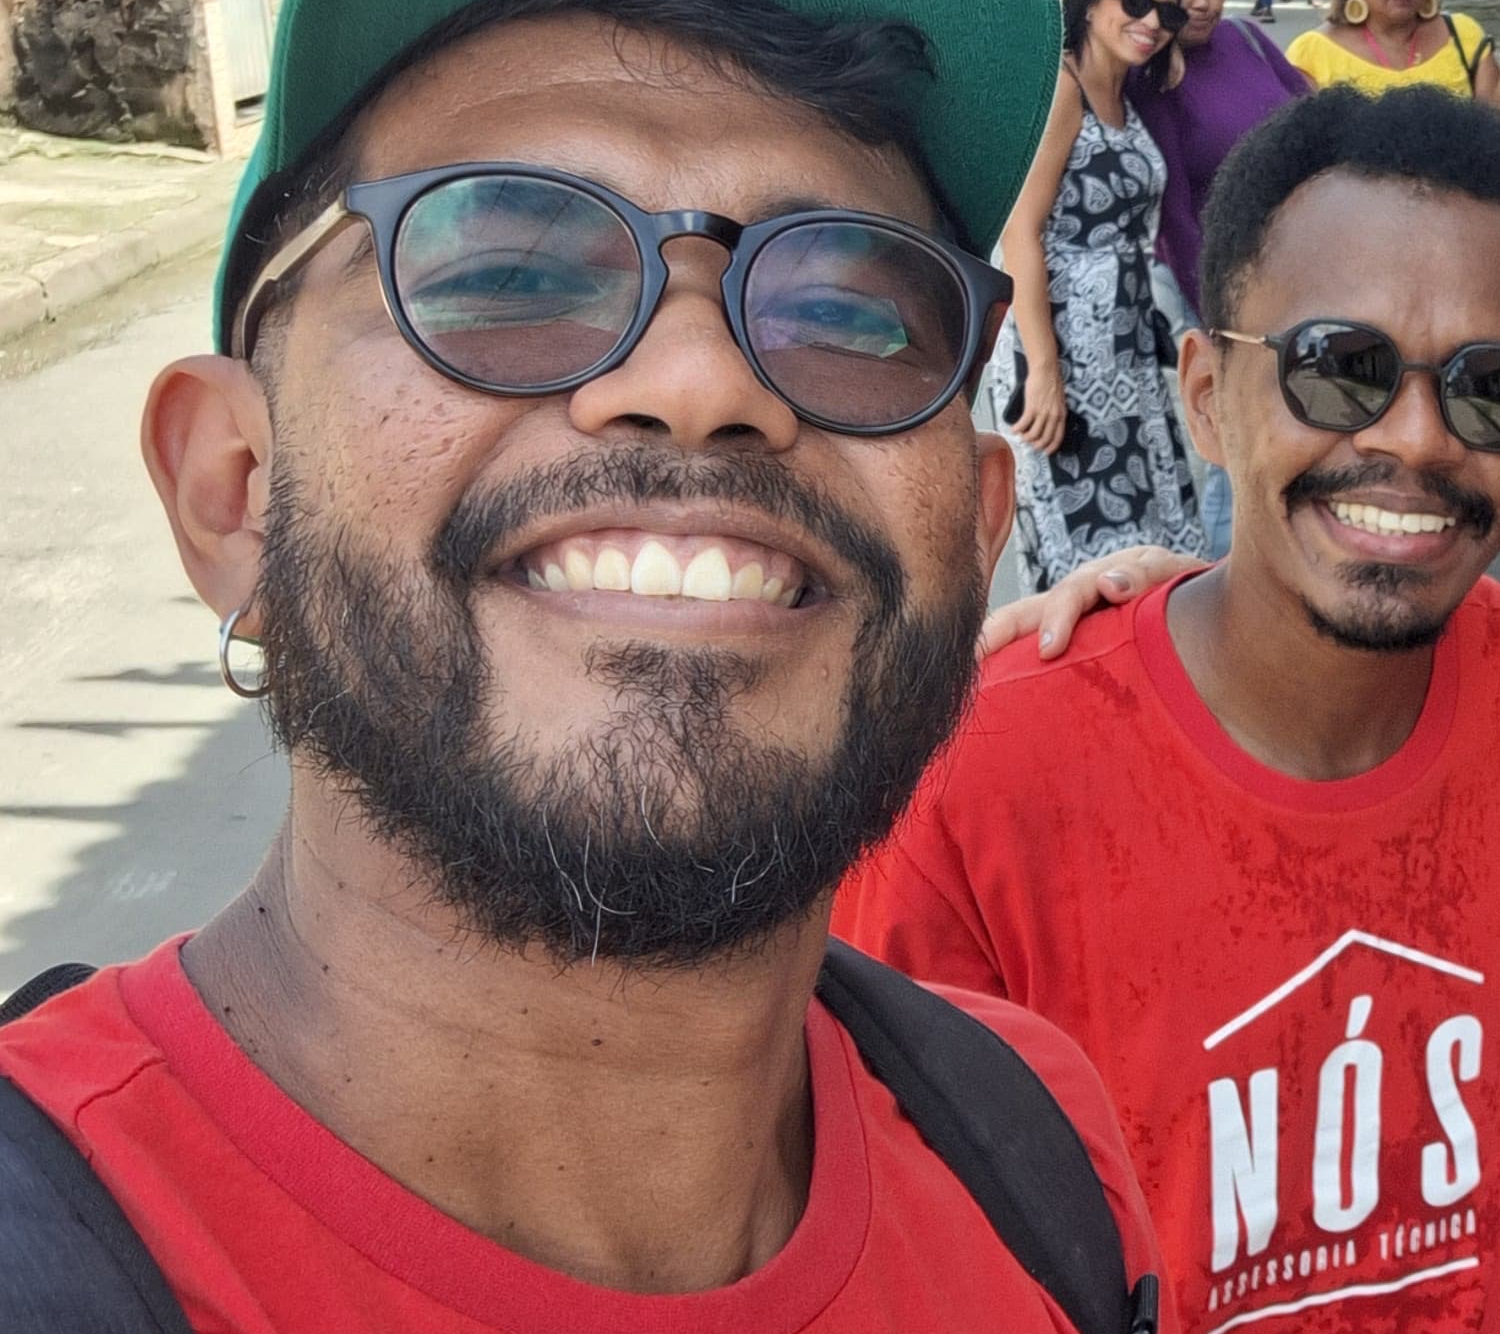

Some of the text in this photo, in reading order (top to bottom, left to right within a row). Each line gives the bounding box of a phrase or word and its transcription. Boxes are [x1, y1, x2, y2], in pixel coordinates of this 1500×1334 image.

[1207, 994, 1483, 1273] NÓS
[1208, 1208, 1477, 1312] ASSESSORIA TÉCNICA
